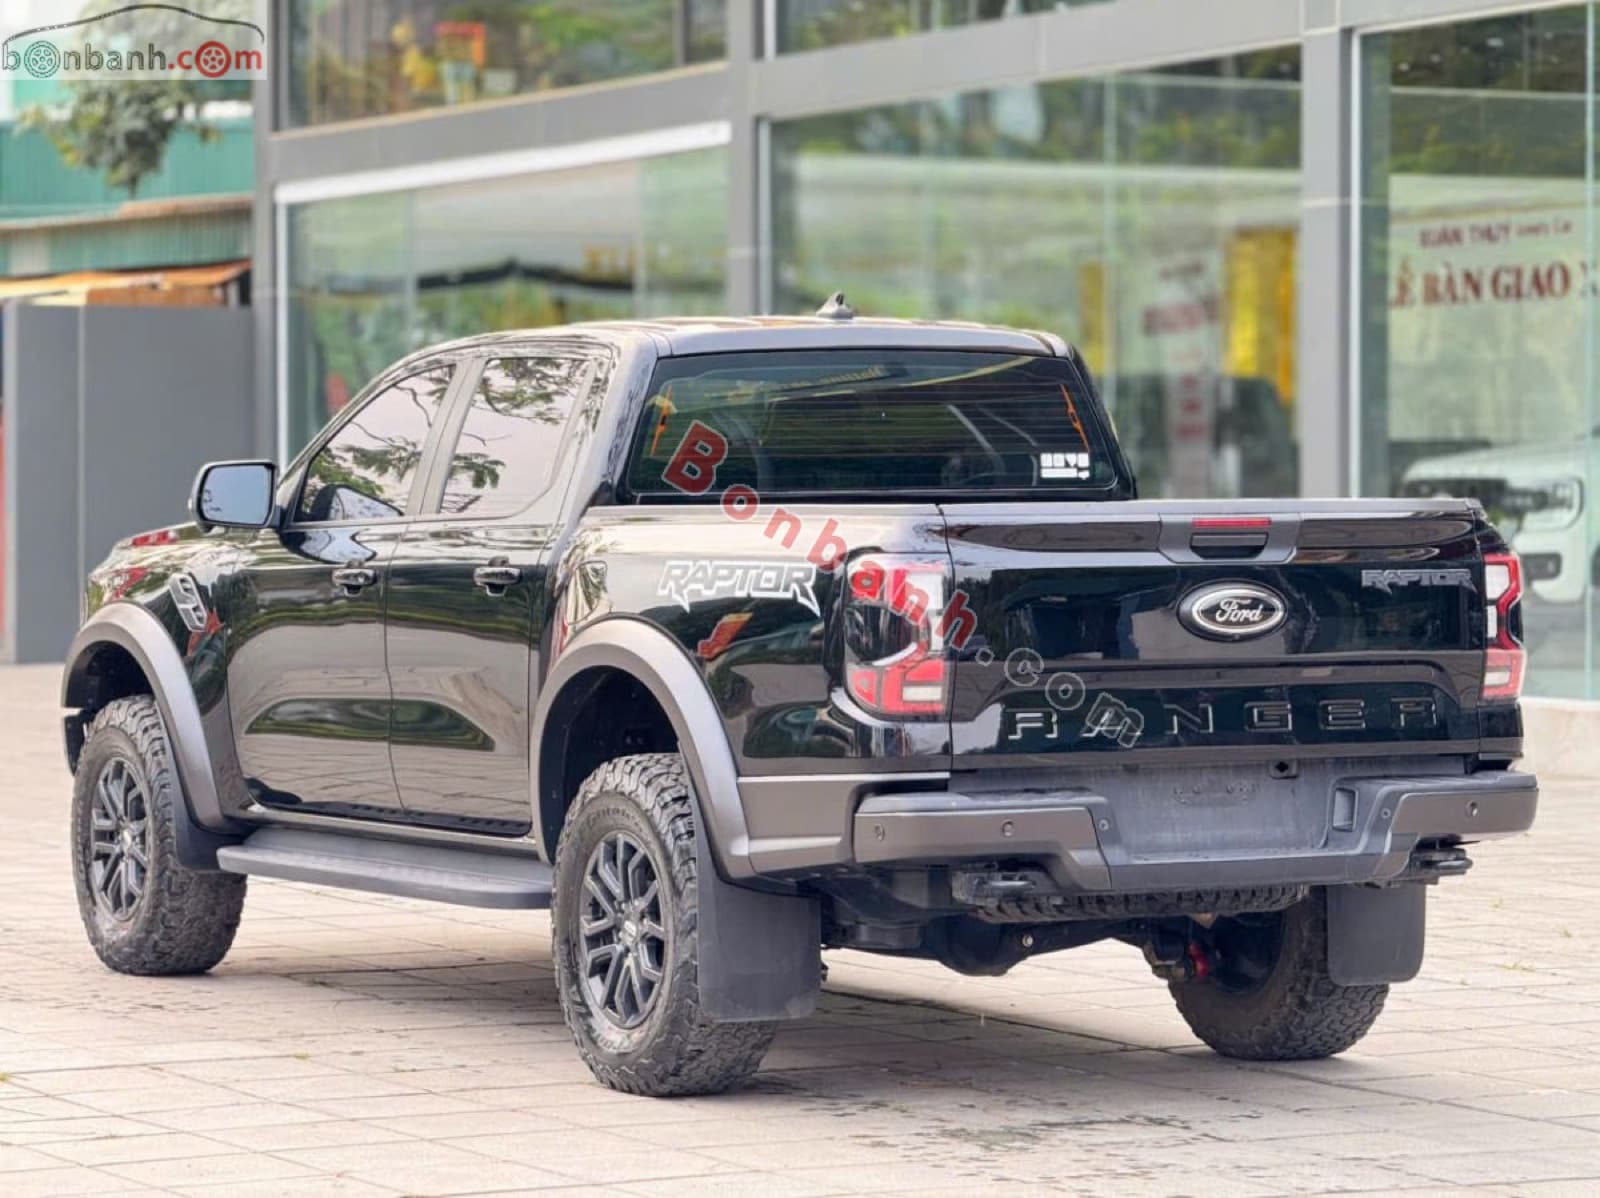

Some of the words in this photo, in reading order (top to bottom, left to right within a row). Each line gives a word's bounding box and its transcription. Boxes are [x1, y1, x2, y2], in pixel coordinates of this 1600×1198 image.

[1423, 260, 1482, 305] BÀN
[1491, 260, 1572, 302] GIAO
[656, 560, 821, 617] RAPTOR
[1360, 568, 1478, 595] RAPTOR
[1216, 598, 1264, 622] Ford
[1005, 696, 1440, 741] RANGER
